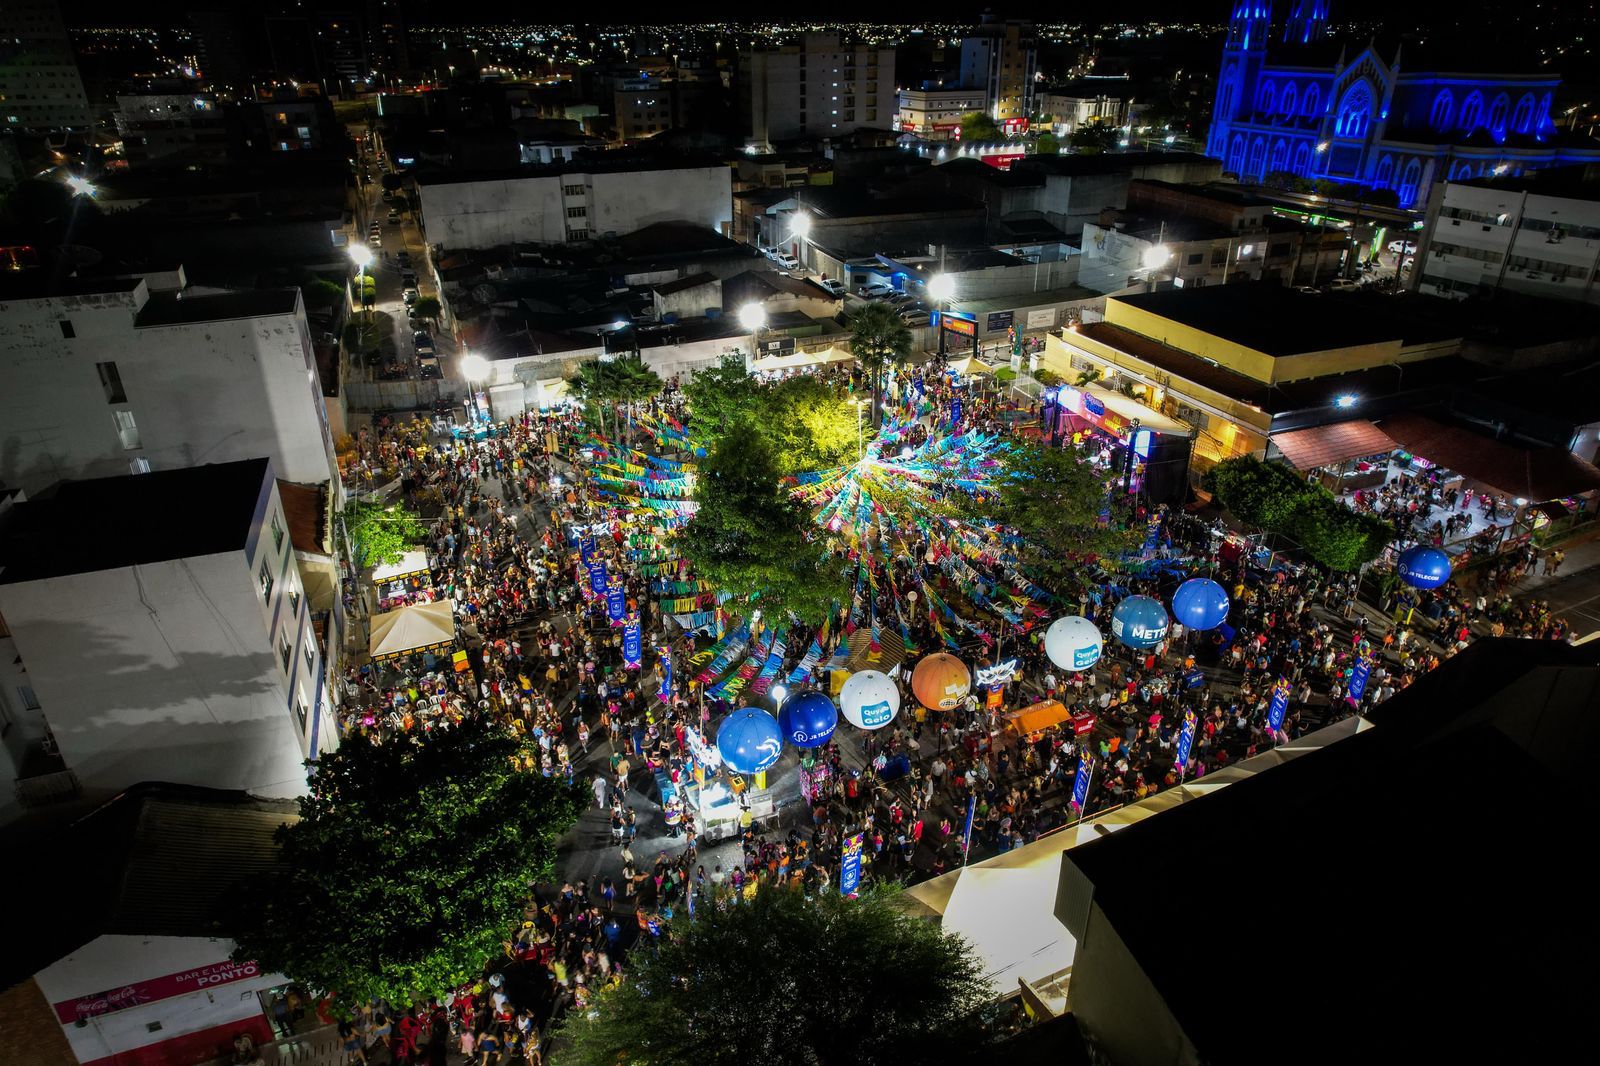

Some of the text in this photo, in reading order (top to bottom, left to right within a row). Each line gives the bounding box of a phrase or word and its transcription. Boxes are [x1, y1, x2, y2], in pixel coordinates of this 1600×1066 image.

[1415, 572, 1440, 581] TELECOM
[1132, 625, 1168, 639] METR
[864, 714, 891, 725] Gelo
[175, 971, 201, 983] BAR
[202, 968, 211, 976] E
[197, 965, 258, 987] PONTO
